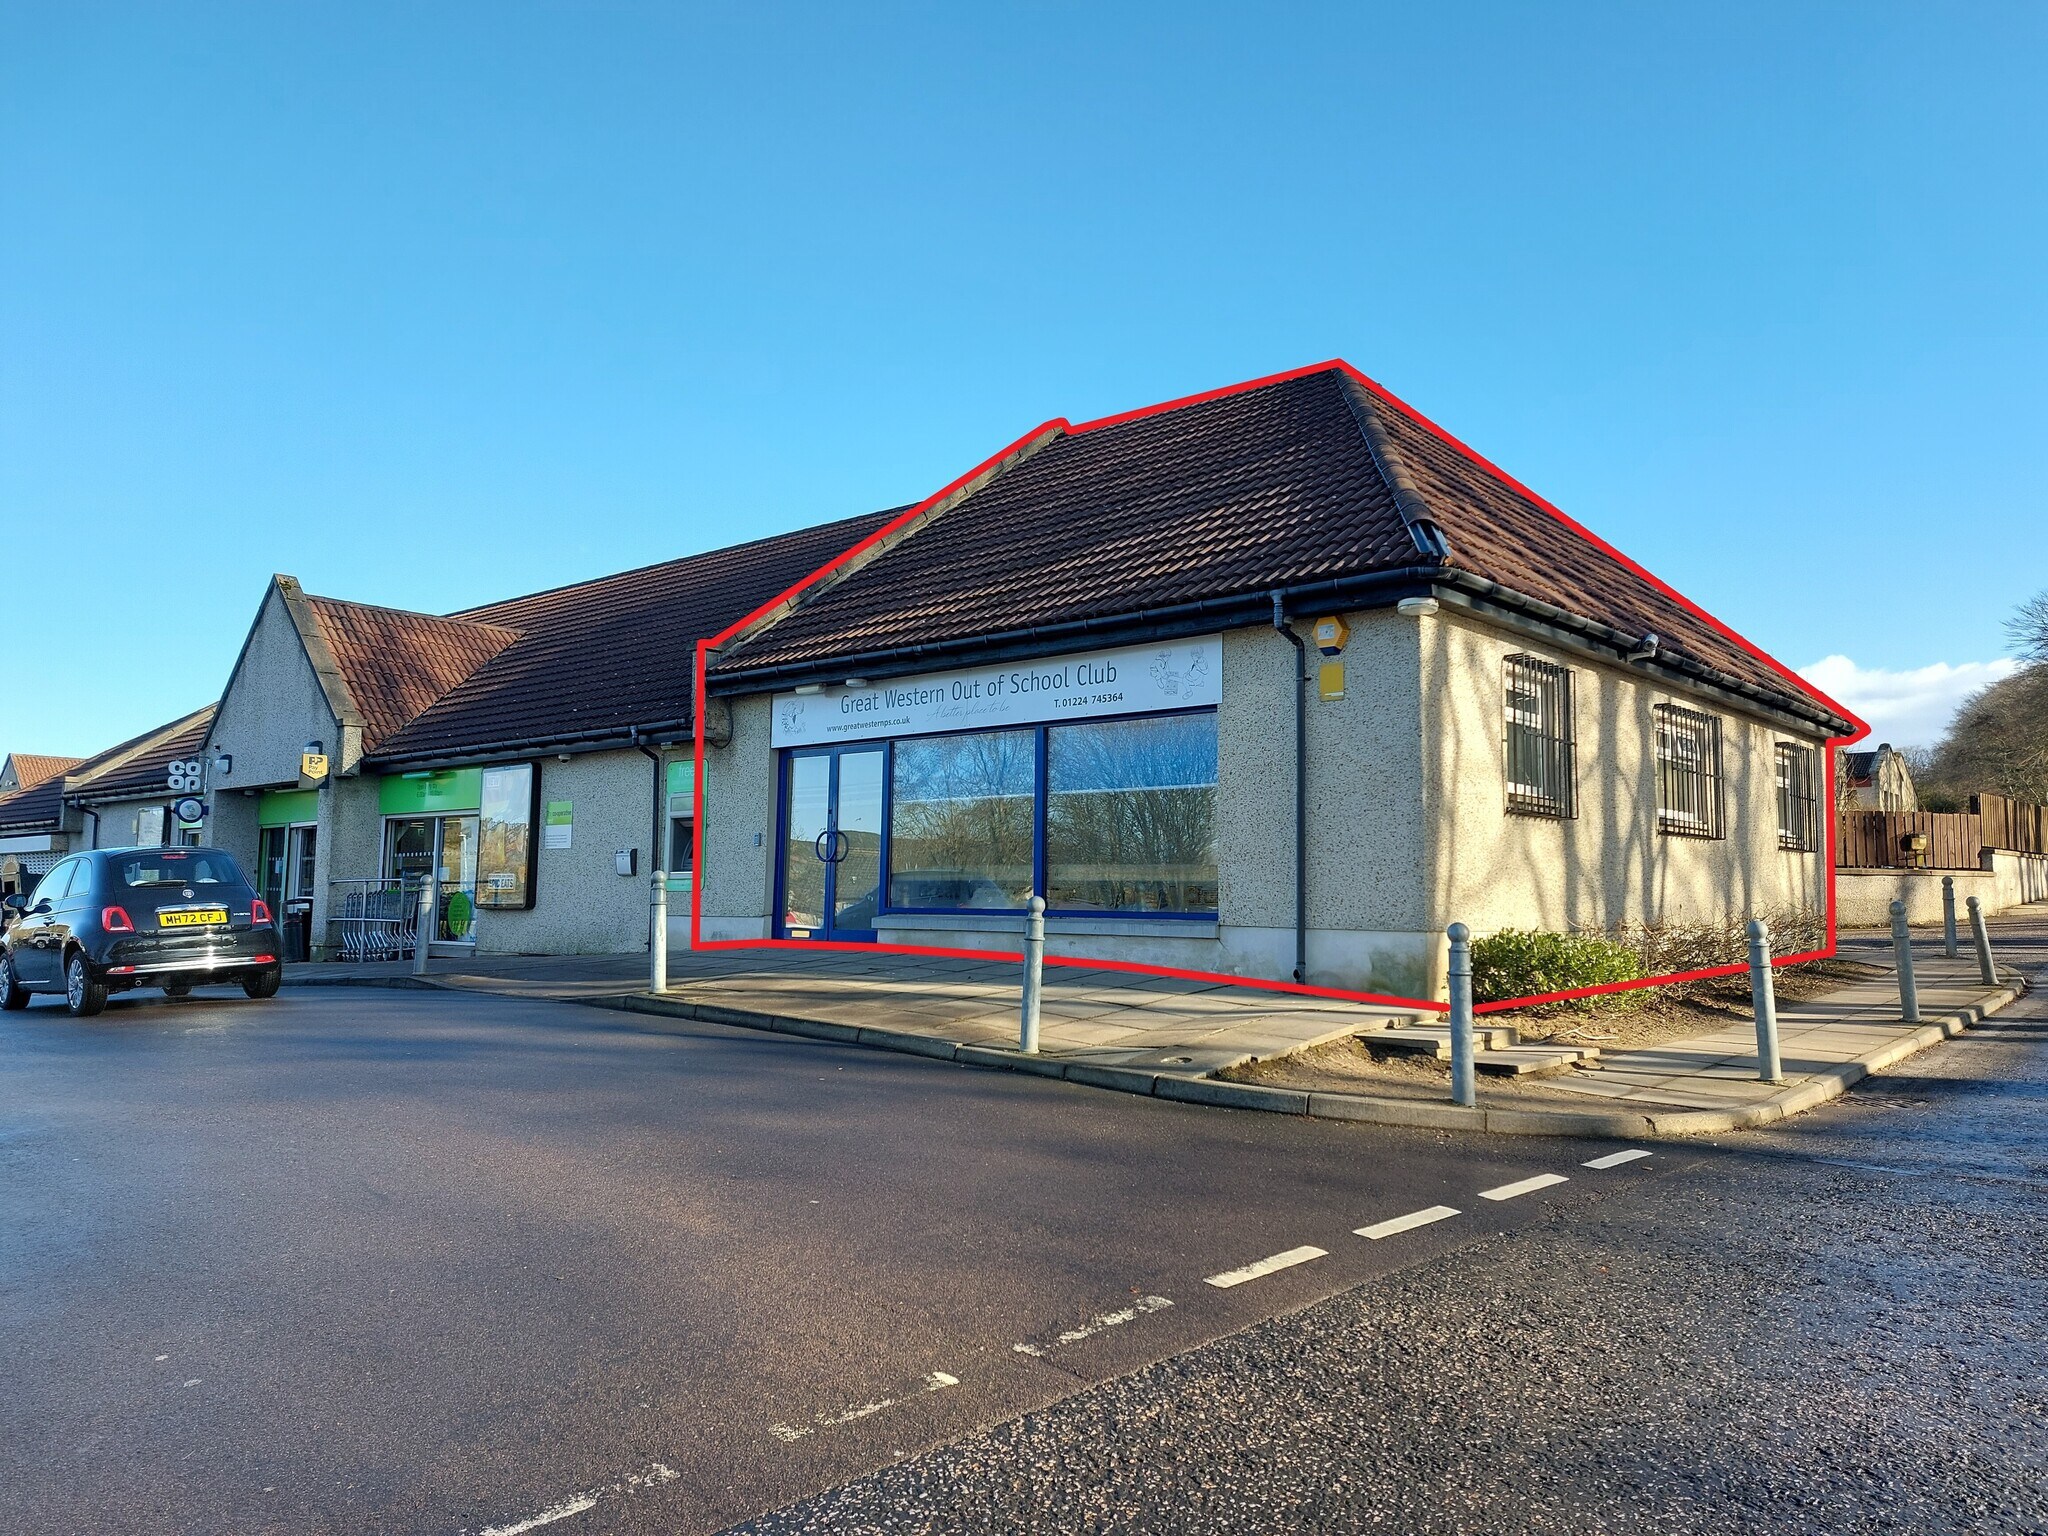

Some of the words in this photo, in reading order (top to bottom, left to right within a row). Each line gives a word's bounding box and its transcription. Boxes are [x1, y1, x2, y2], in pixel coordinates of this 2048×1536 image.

[841, 692, 879, 714] Great
[884, 686, 944, 710] Western
[952, 679, 980, 702] Out
[987, 674, 1005, 697] of
[1010, 666, 1070, 694] School
[1077, 661, 1117, 686] Club
[1091, 692, 1123, 704] 745364
[941, 704, 963, 718] better
[962, 701, 986, 722] place
[986, 700, 997, 713] to
[1000, 698, 1010, 712] be
[827, 716, 911, 733] www.greatwesternps.co.uk
[166, 914, 197, 925] MH72
